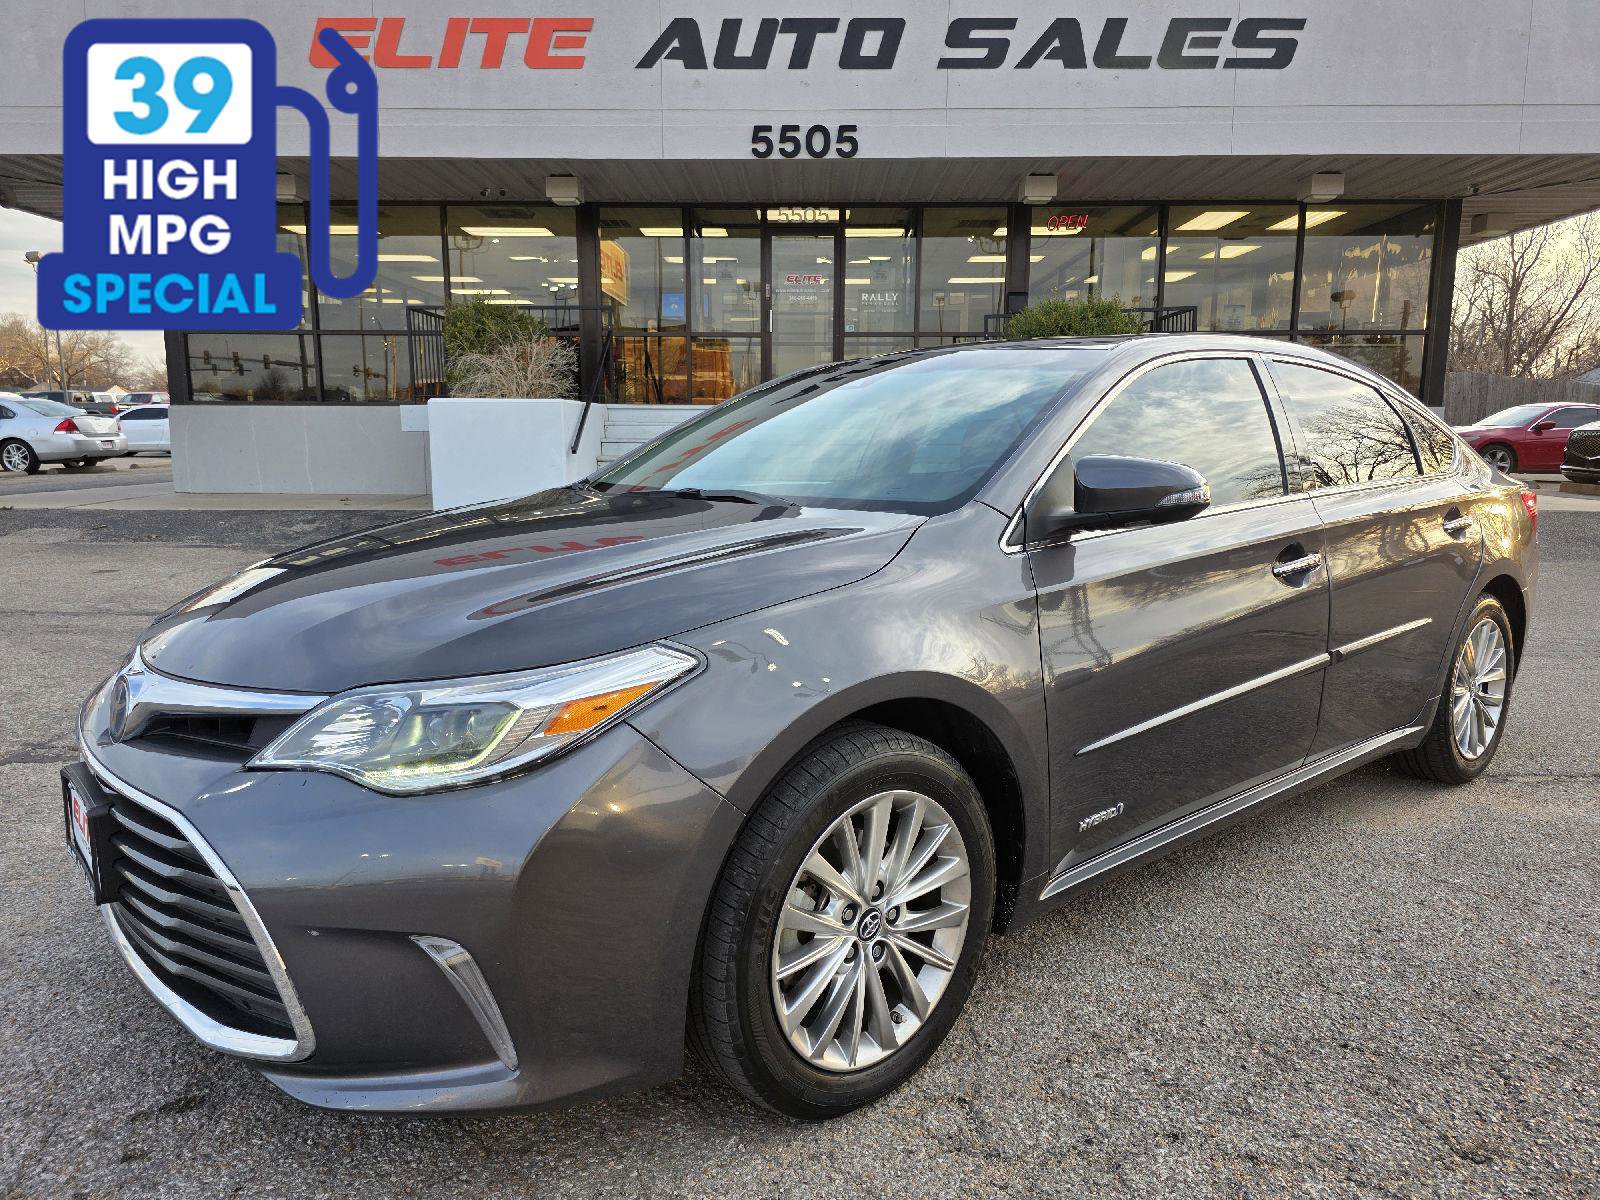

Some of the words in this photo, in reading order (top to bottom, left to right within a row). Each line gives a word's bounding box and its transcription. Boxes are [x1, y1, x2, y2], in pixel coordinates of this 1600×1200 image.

[309, 17, 594, 69] ELITE
[635, 17, 907, 70] AUTO
[937, 17, 1307, 70] SALES
[751, 124, 860, 159] 5505
[777, 206, 830, 224] 5505
[1047, 214, 1089, 232] OPEN
[786, 274, 822, 283] ELITE
[861, 292, 899, 301] RALLY
[1078, 806, 1117, 833] HYBRID
